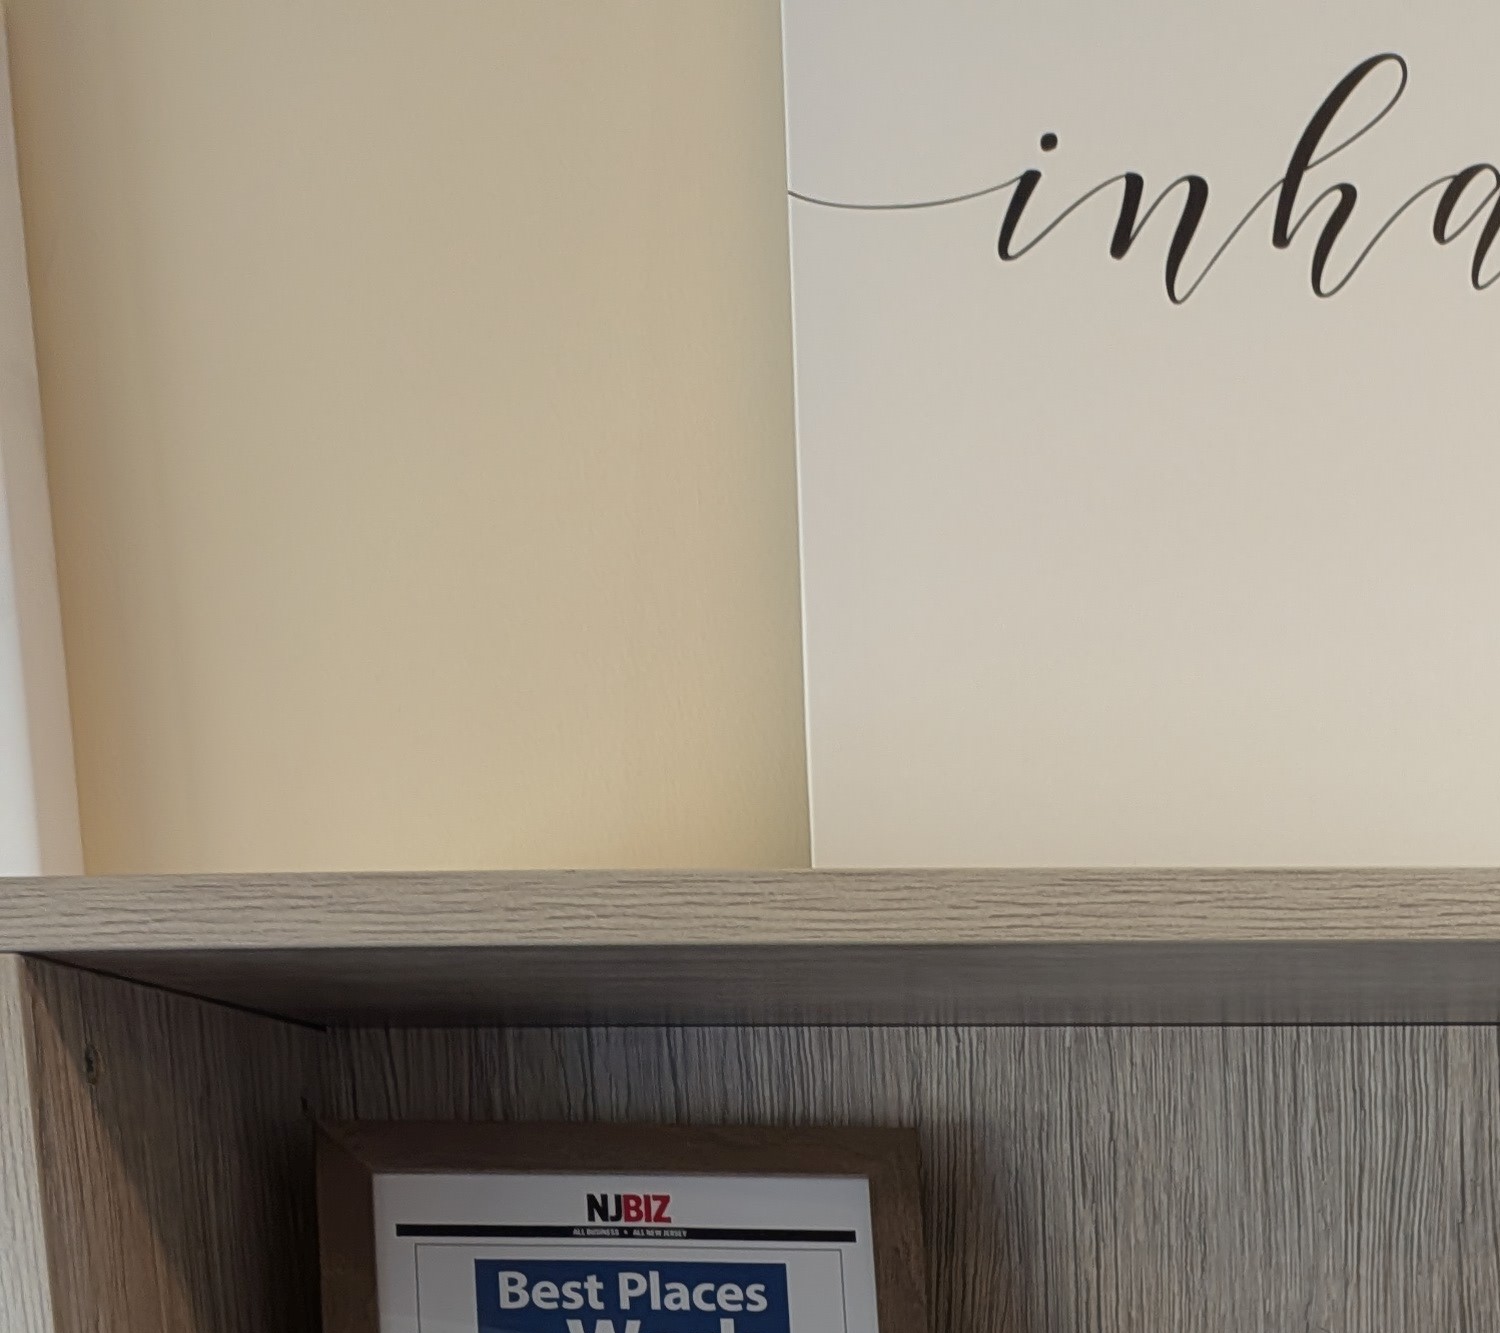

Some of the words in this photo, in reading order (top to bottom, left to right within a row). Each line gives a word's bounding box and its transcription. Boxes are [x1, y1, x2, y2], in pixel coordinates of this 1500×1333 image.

[586, 1193, 672, 1223] NJBIZ
[498, 1270, 605, 1311] Best
[618, 1270, 769, 1313] Places
